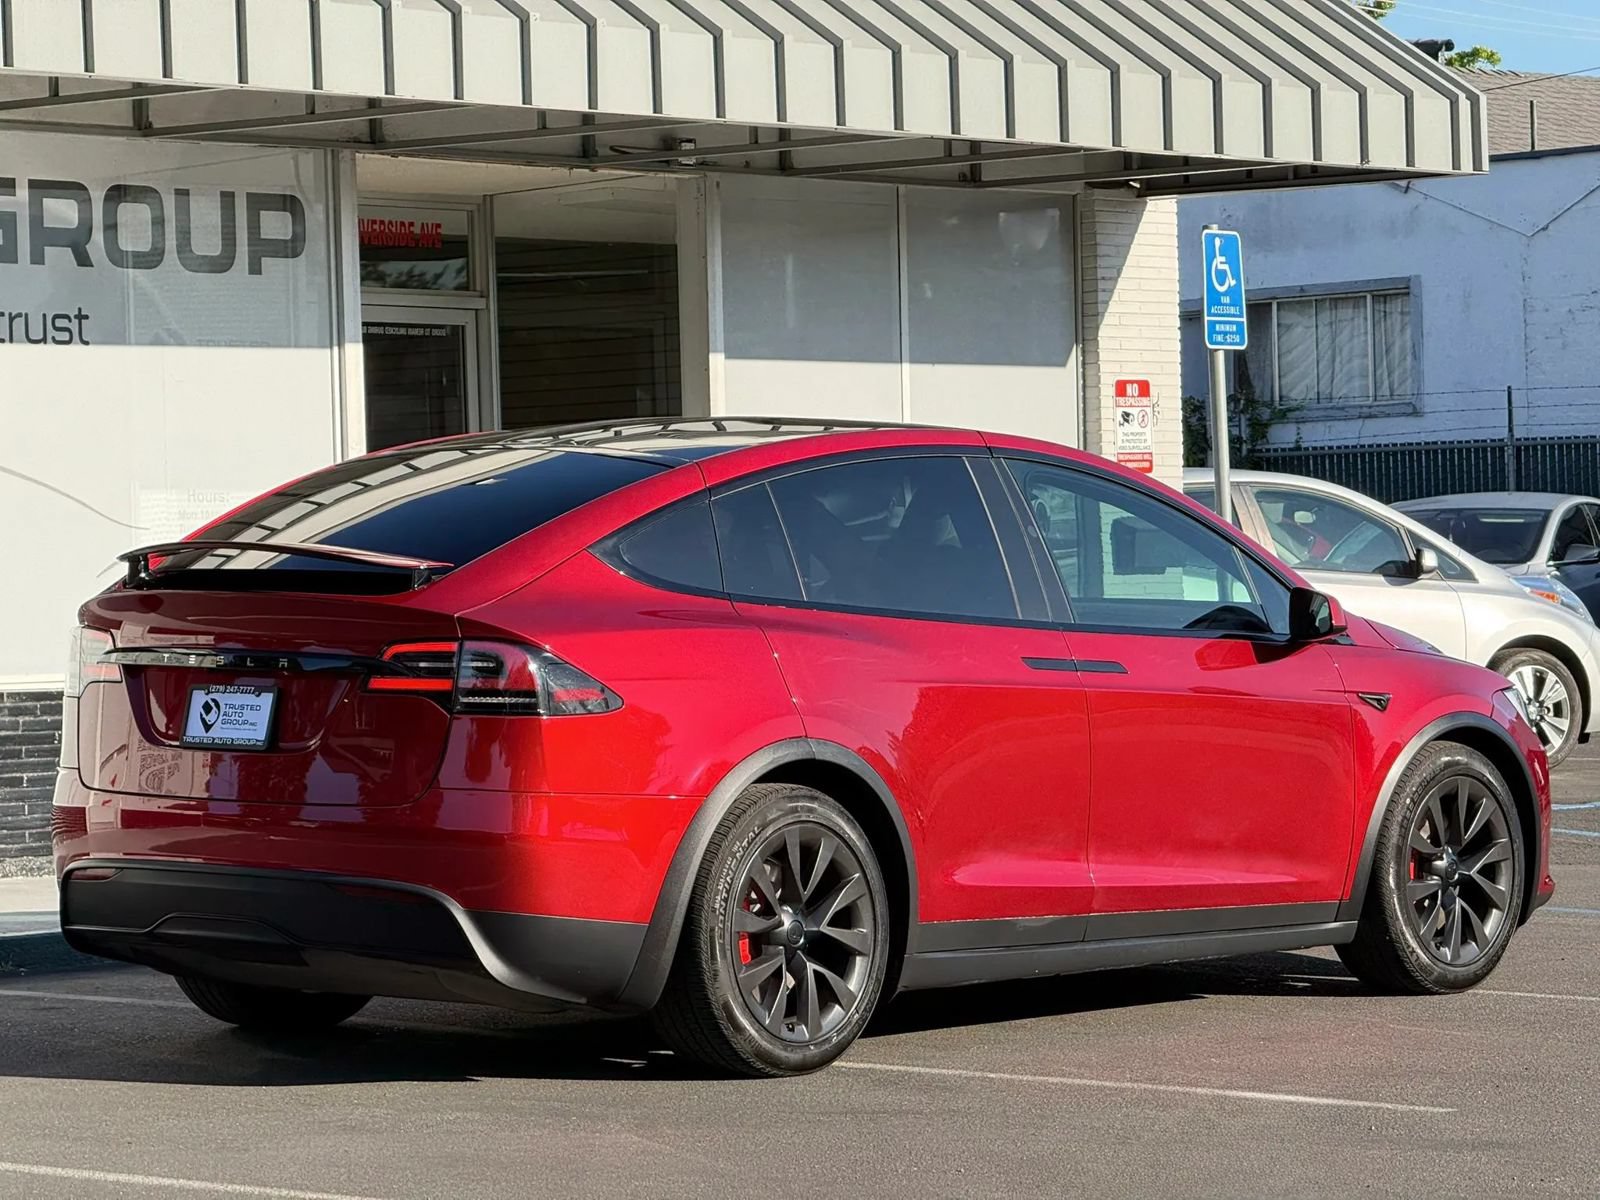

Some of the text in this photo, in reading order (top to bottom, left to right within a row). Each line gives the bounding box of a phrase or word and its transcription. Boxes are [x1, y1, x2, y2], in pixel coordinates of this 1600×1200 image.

[0, 177, 306, 275] ROUP
[419, 222, 442, 249] AVE
[1211, 306, 1240, 314] ACCESSIBLE
[1215, 323, 1237, 332] MINIMUM
[1126, 383, 1139, 396] NO
[161, 653, 289, 668] TESLA
[209, 685, 255, 694] (279) 247-7777
[223, 703, 262, 712] TRUSTED
[221, 711, 244, 719] AUTO
[220, 718, 249, 726] GROUP
[183, 736, 212, 744] TRUSTED
